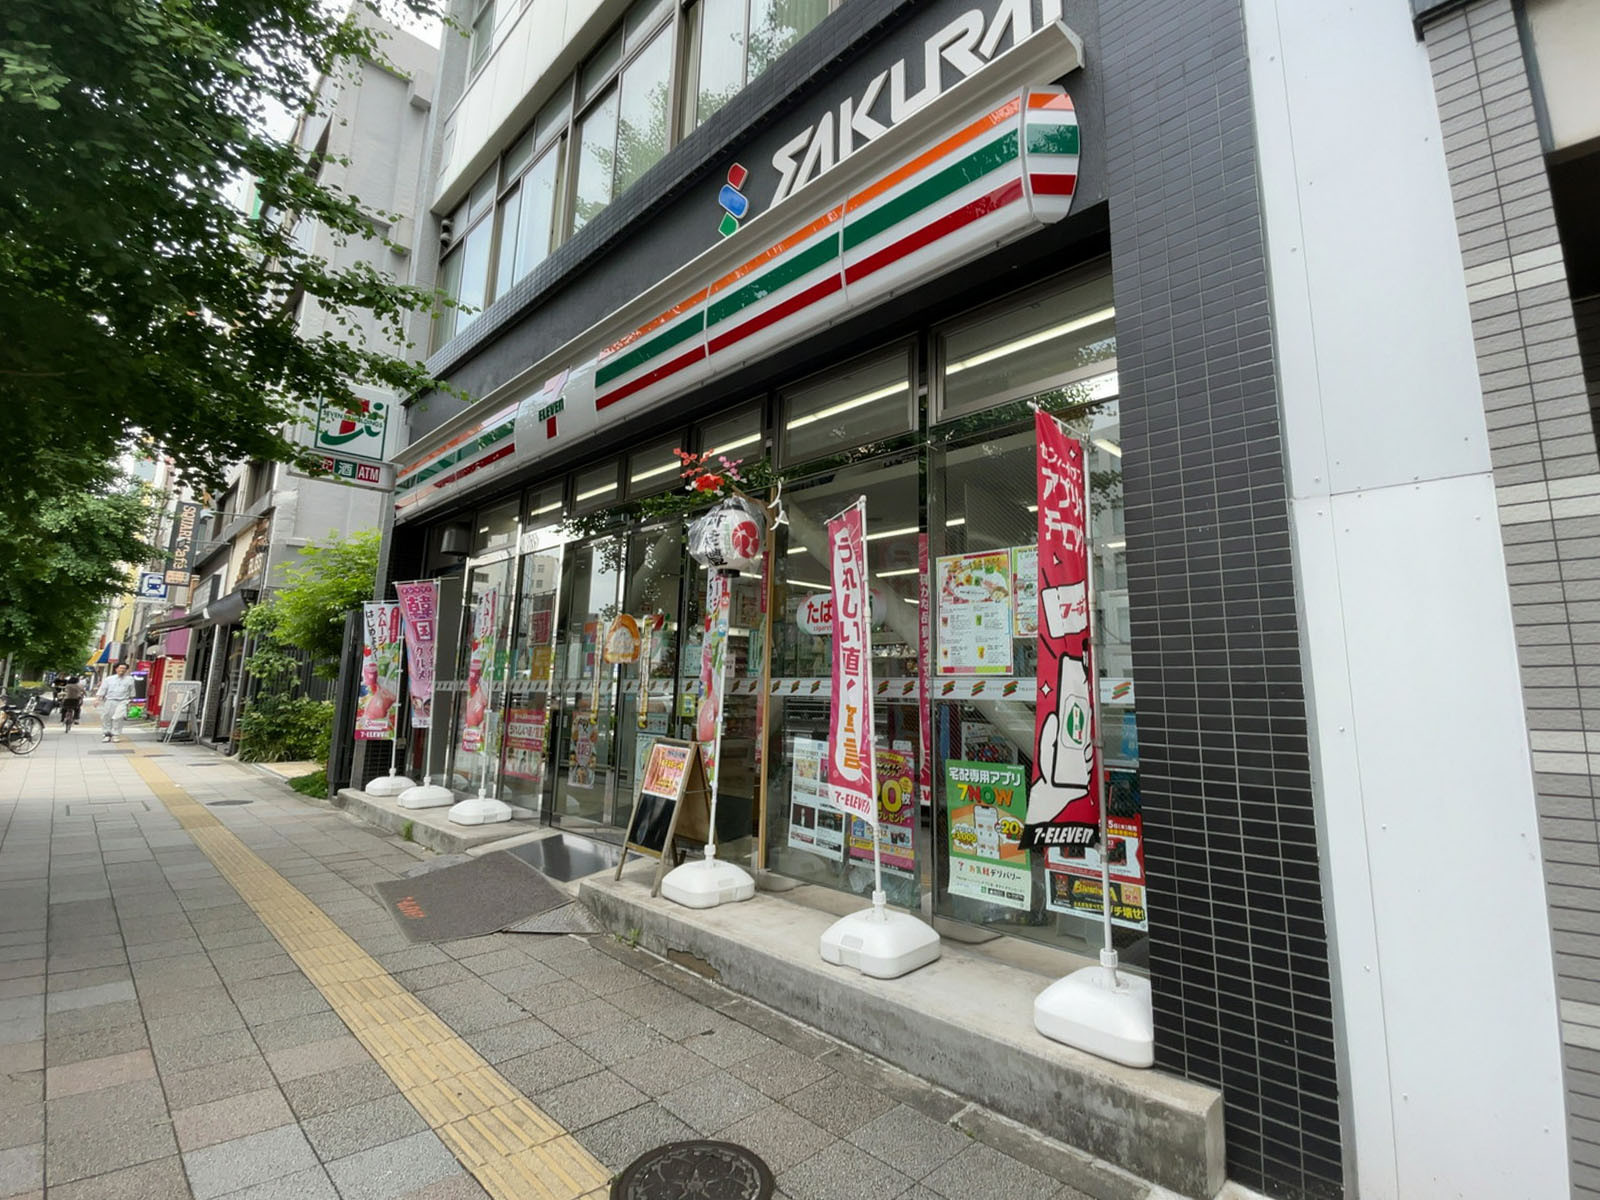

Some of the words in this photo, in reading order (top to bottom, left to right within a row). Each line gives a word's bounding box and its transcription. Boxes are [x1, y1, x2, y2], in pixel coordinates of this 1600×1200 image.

[770, 0, 1063, 209] SAKURA
[358, 464, 380, 482] ATM
[949, 766, 1021, 787] 宅配専用アプリ
[957, 784, 1014, 807] 7NOW
